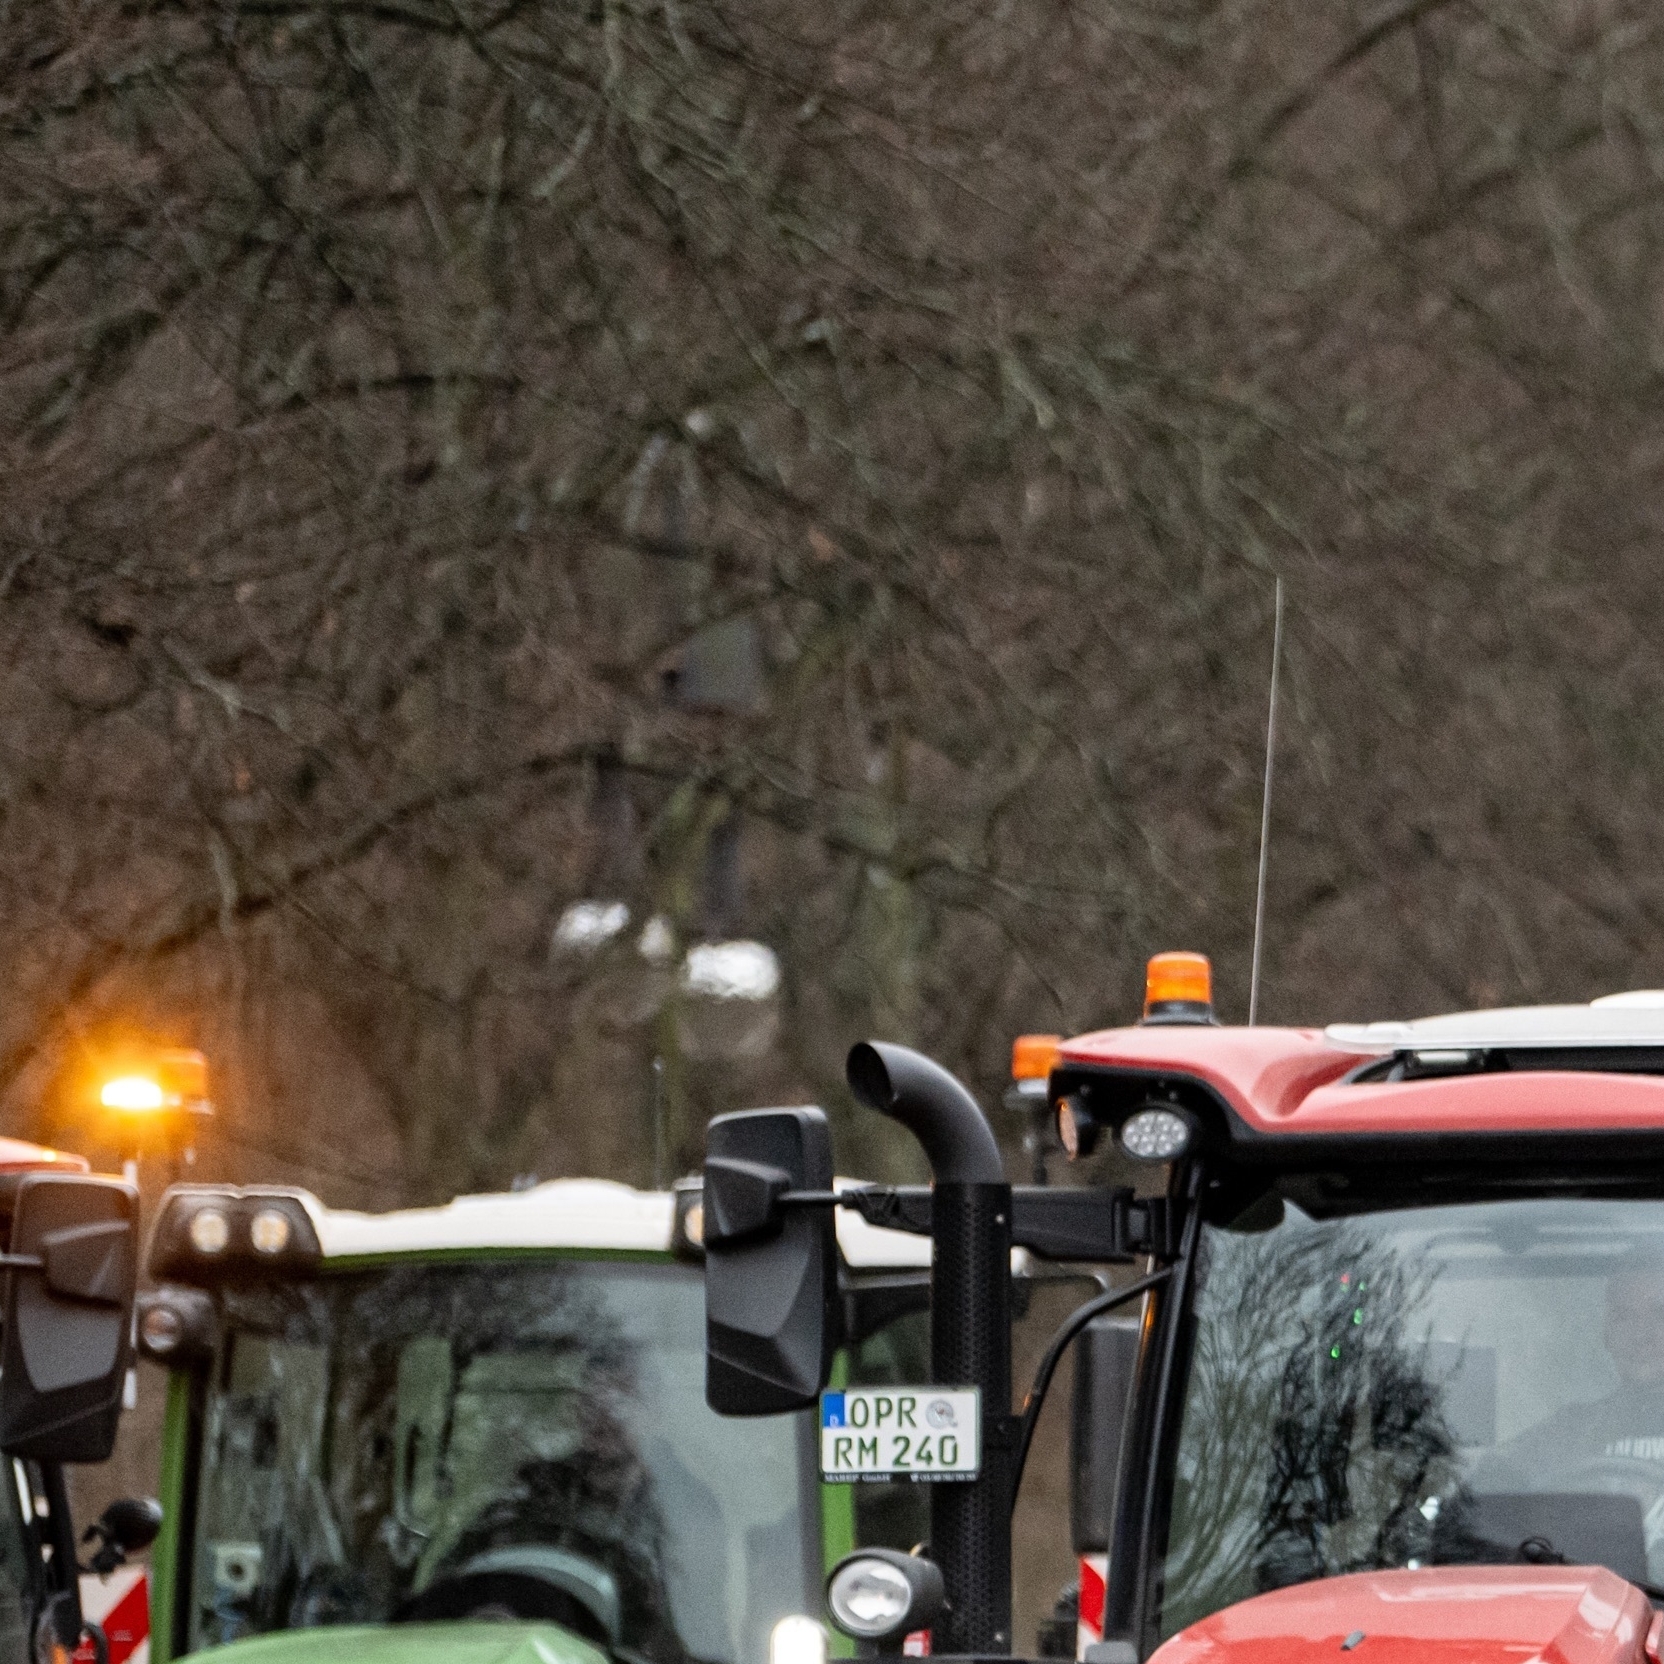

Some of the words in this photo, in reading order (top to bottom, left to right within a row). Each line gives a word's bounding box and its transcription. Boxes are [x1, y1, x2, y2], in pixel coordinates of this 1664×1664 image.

[850, 1397, 917, 1428] OPR
[834, 1435, 878, 1468] RM
[892, 1434, 958, 1467] 240
